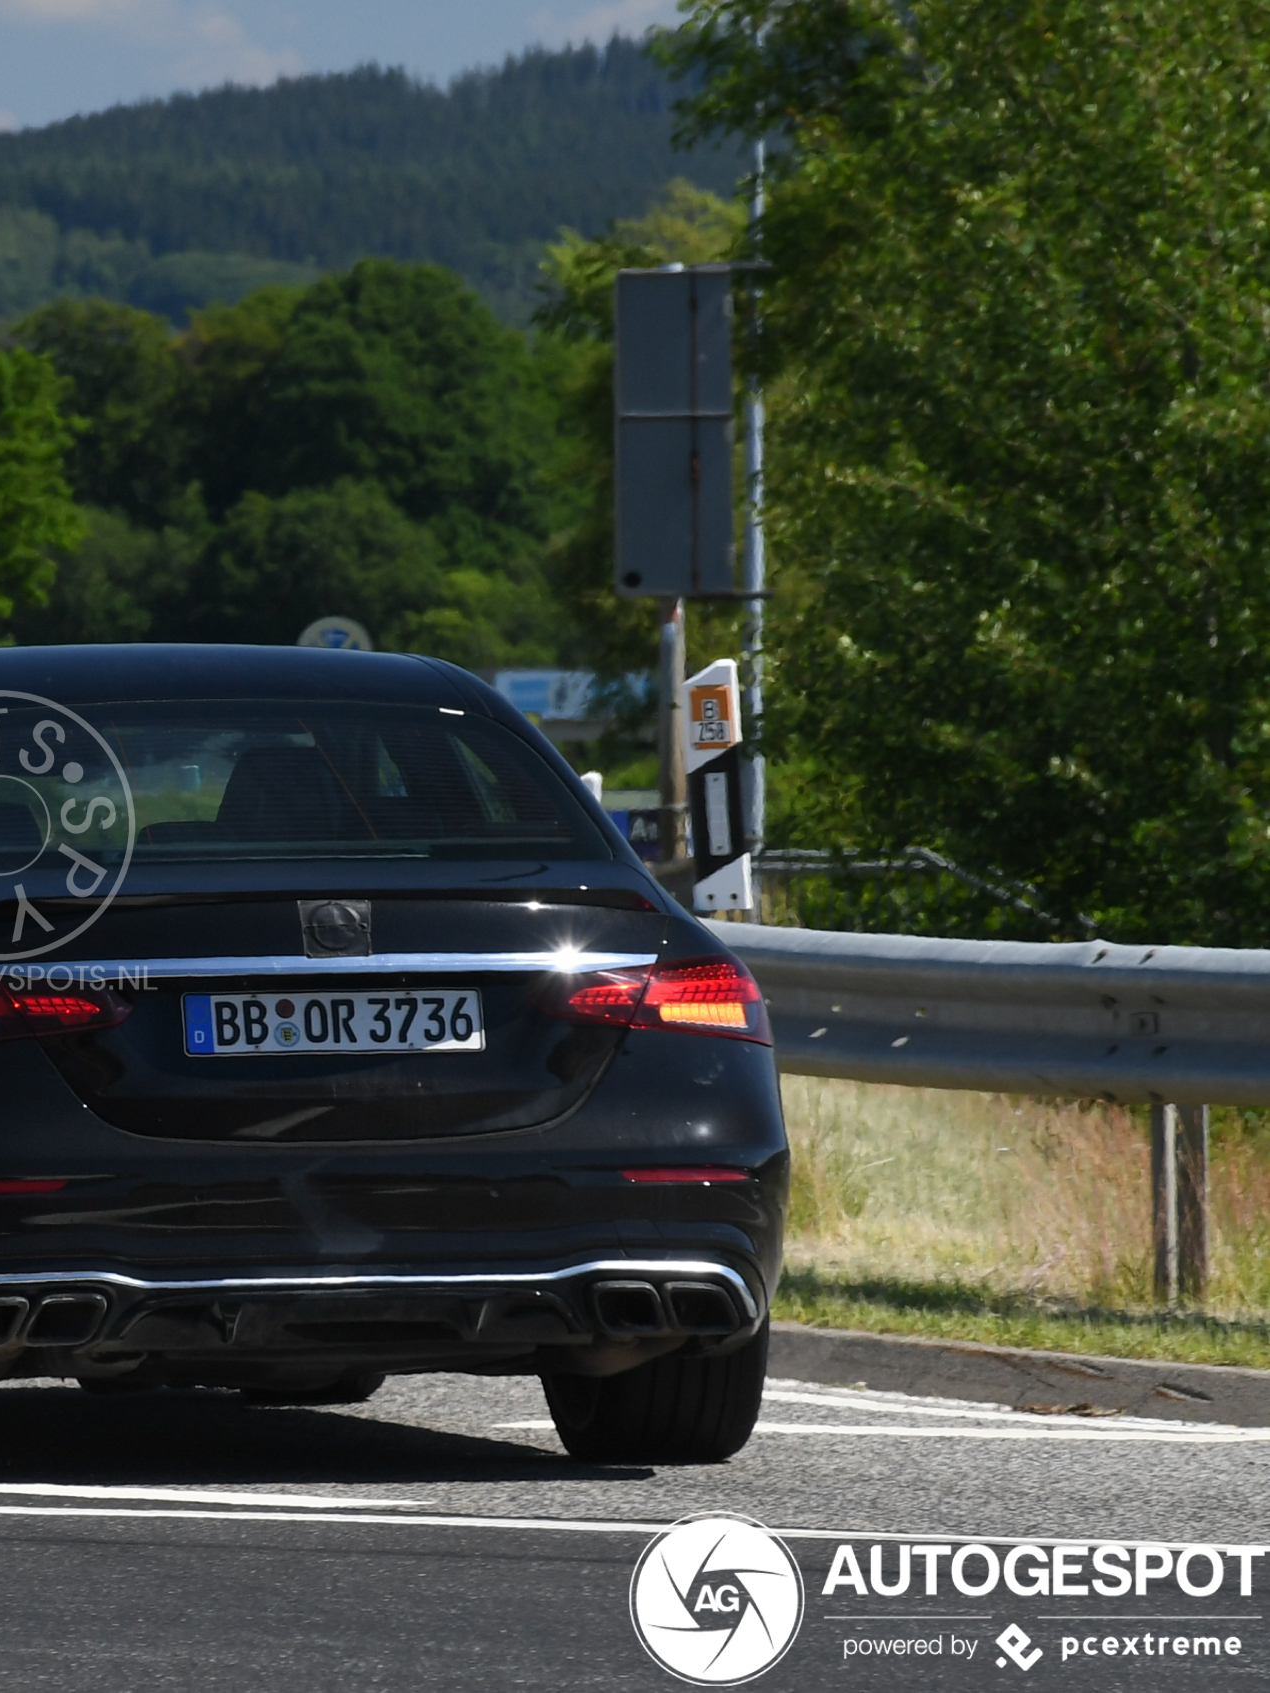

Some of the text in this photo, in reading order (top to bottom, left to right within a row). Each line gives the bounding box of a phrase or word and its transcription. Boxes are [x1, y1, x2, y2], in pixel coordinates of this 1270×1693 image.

[703, 700, 715, 719] B
[214, 996, 474, 1046] BB OR 3736
[193, 1030, 205, 1044] D
